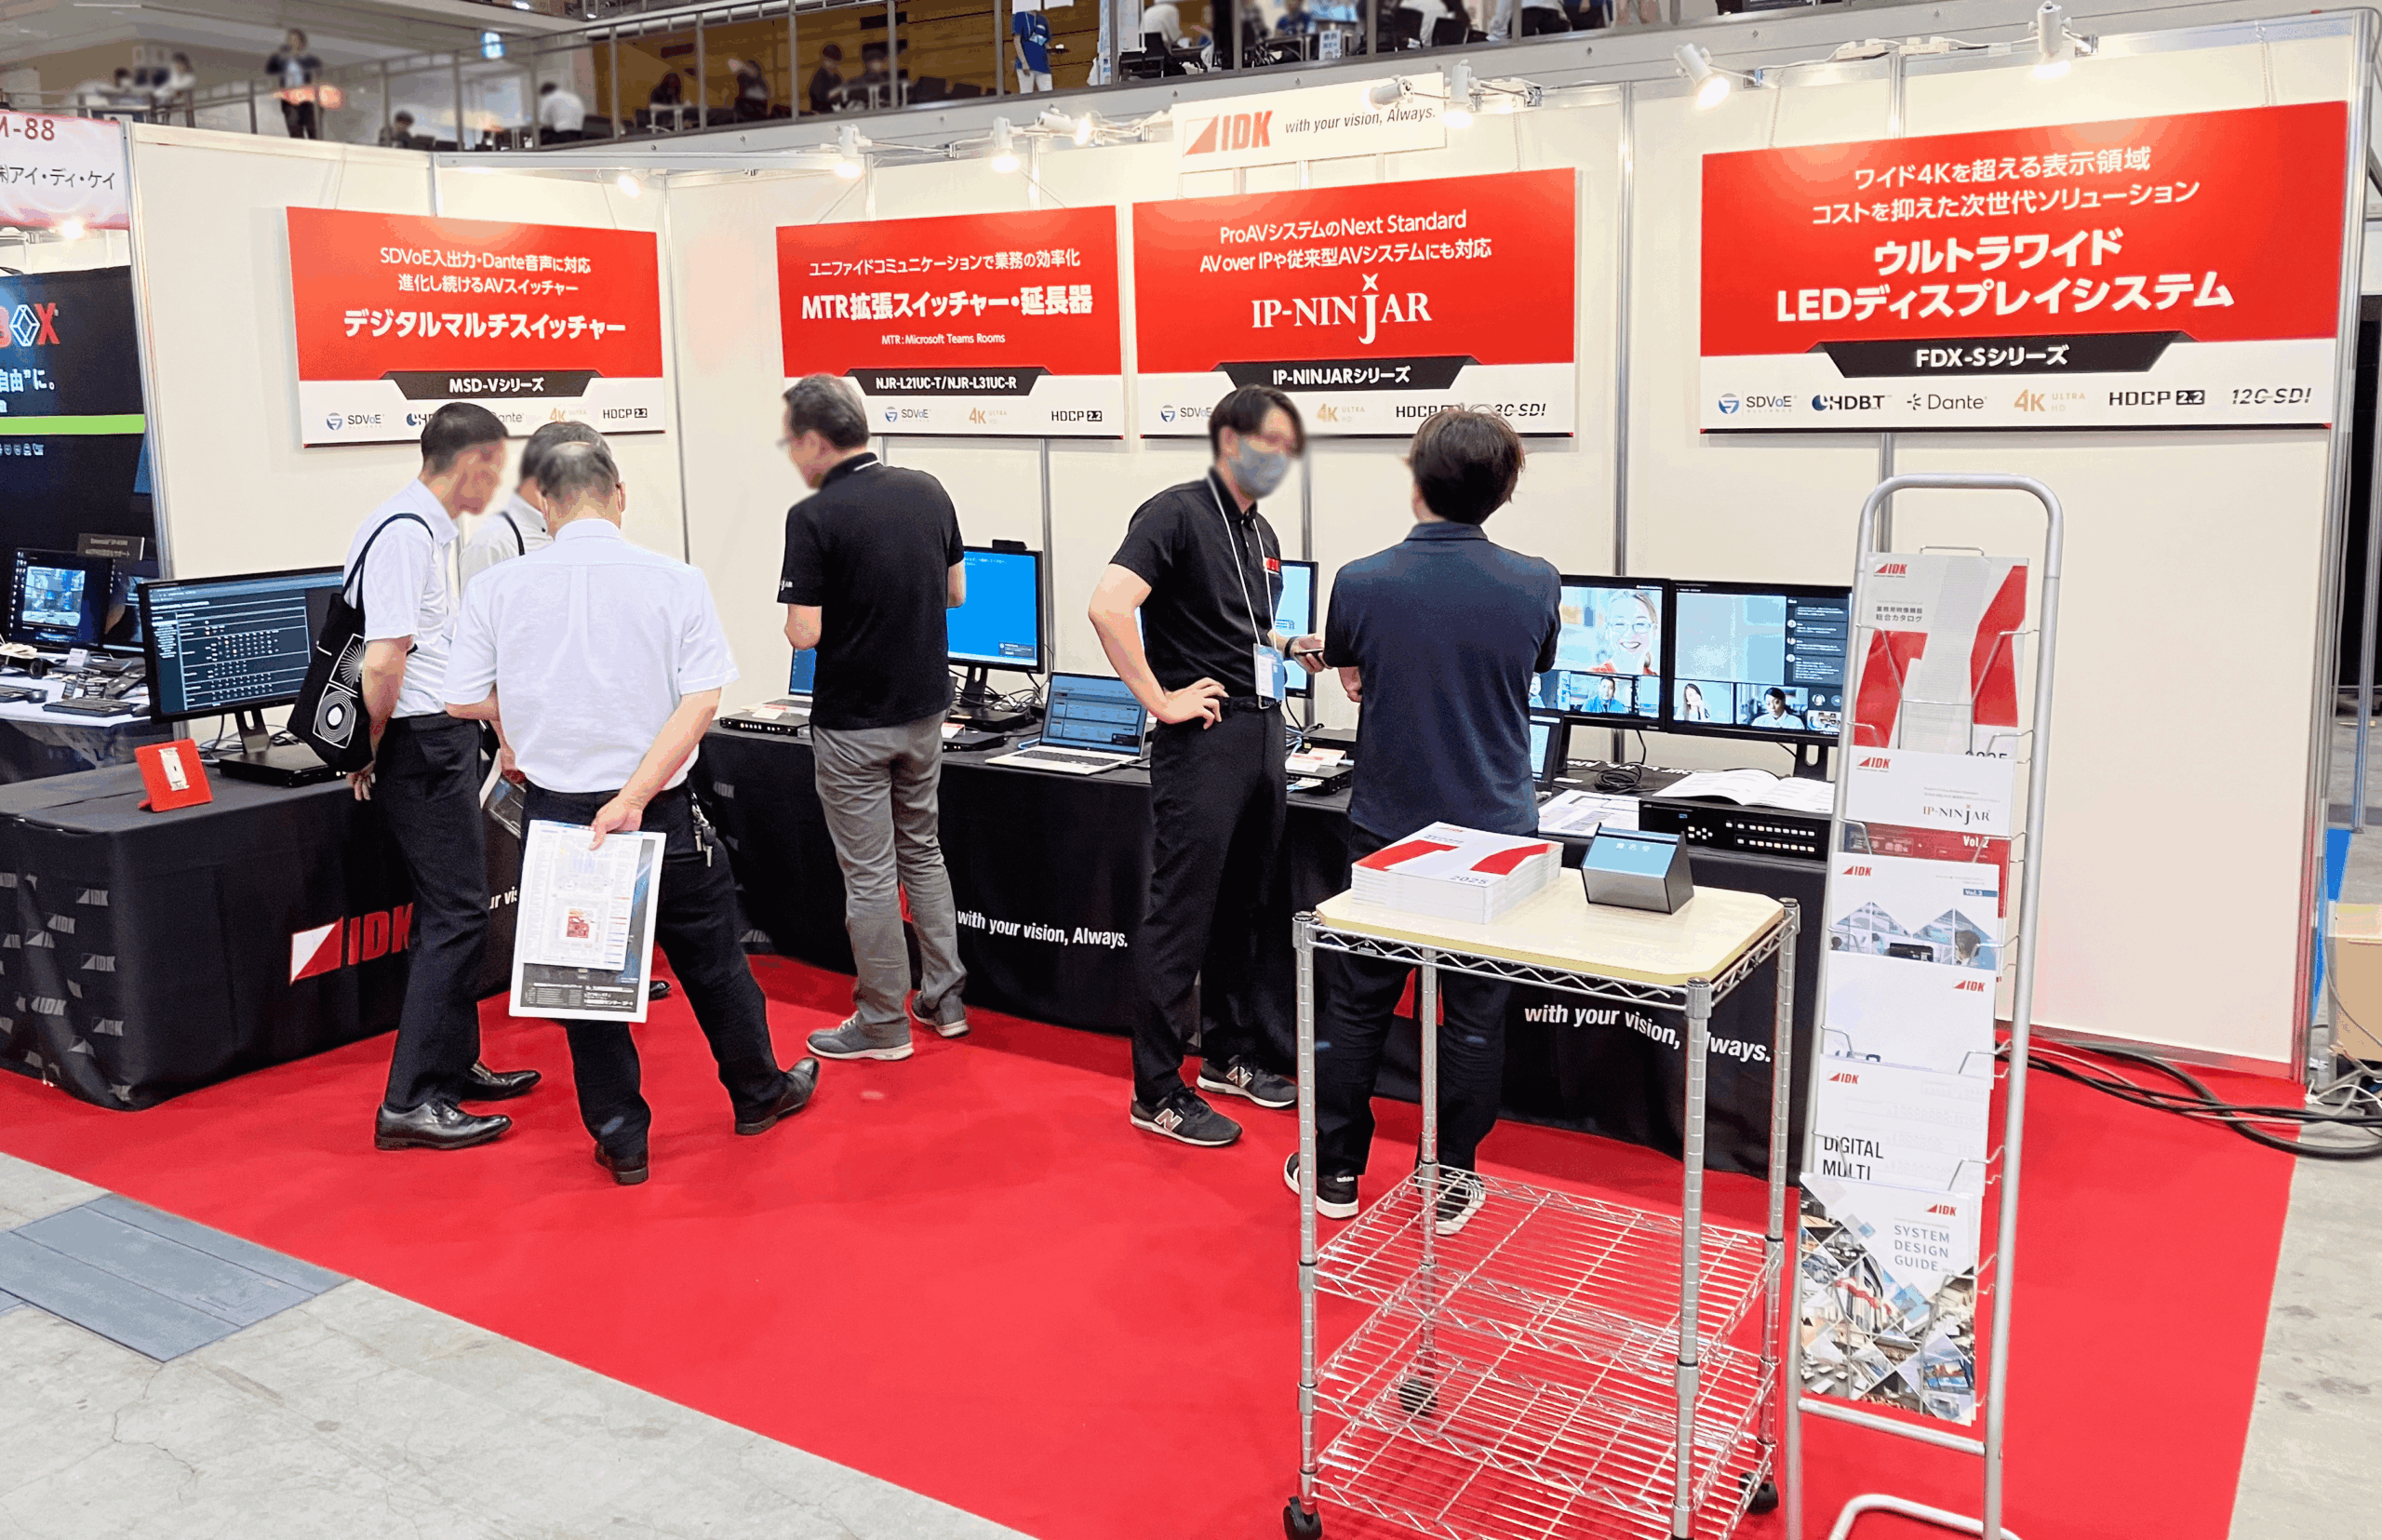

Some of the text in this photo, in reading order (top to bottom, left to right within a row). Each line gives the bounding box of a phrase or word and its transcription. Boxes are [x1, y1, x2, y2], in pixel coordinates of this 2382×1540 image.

[1221, 108, 1436, 151] IDK with your vision, Always.
[1853, 146, 2151, 190] ワイド4Kを超える表示領域
[1813, 181, 2200, 225] コストを抑えた次世代ソリューション
[1220, 209, 1466, 244] ProAVシステムのNext Standard
[381, 248, 592, 274] SDVoE入出力・Dante音声に対応
[810, 248, 1080, 276] ユニファイドコミュニケーションで業務の効率化
[1259, 238, 1492, 269] IPや従来型AVシステムにも対応
[1874, 228, 2123, 275] ウルトラワイド
[398, 274, 579, 296] 進化し続けるAVスイッチャー
[802, 285, 1092, 320] MTR拡張スイッチャー・延長器
[1777, 272, 2234, 322] LEDディスプレイシステム
[344, 309, 625, 340] デジタルマルチスイッチャー
[947, 333, 974, 344] Teams
[977, 333, 1005, 343] Rooms
[1917, 344, 2069, 368] FDX-Sシリーズ
[448, 376, 544, 393] MSD-Vシリーズ
[876, 376, 1016, 390] NJR-L21UC-T/NJR-L31UC-R
[1273, 366, 1411, 386] IP-NINJARシリーズ
[1746, 395, 1792, 408] SDVoE
[1928, 395, 1984, 409] Dante
[2014, 389, 2045, 411] 4K
[2051, 393, 2086, 401] ULTRA
[2108, 391, 2172, 406] HDCP
[2176, 391, 2204, 405] 2.2
[2051, 404, 2066, 412] HD
[348, 414, 381, 424] SDVoE
[603, 408, 633, 419] HDCP
[635, 408, 648, 419] 2.2
[901, 409, 929, 419] SDVoE
[969, 408, 986, 424] 4K
[1051, 410, 1084, 422] HDCP
[1087, 410, 1103, 422] 2.2
[1317, 404, 1338, 422] 4K
[1888, 564, 1907, 574] IDK
[1870, 757, 1891, 770] IDK
[1963, 836, 1989, 849] Vol2
[1854, 866, 1872, 877] IDK
[348, 903, 413, 966] IDK
[957, 910, 1128, 949] with your vision, Always.
[1966, 981, 1986, 992] IDK
[1524, 1005, 1772, 1063] with your vision, lways.
[1840, 1073, 1859, 1085] IDK
[1824, 1136, 1884, 1159] DIGITAL
[1823, 1159, 1871, 1181] MULTI
[1939, 1204, 1958, 1217] IDK
[1894, 1225, 1949, 1244] SYSTEM
[1894, 1239, 1948, 1259] DESIGN
[1894, 1254, 1939, 1271] GUIDE
